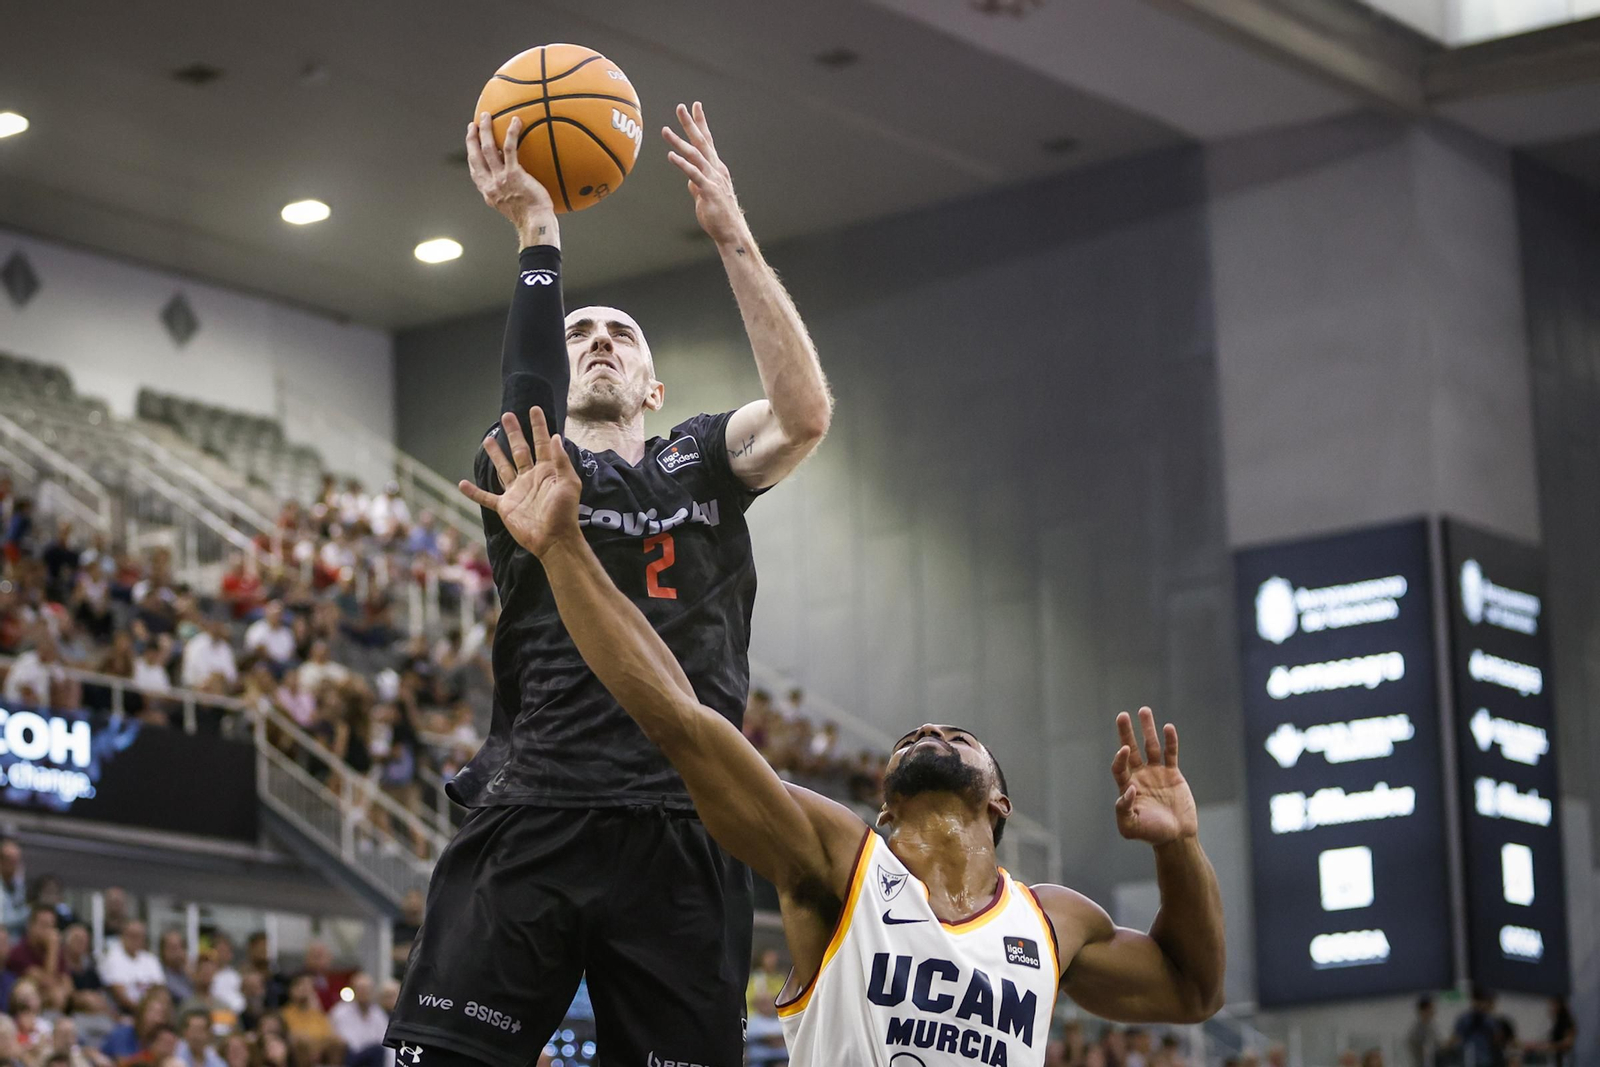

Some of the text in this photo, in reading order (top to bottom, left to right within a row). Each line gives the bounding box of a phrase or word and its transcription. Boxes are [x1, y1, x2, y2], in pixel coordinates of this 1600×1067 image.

[662, 451, 680, 464] liga
[667, 452, 700, 468] endesa
[643, 533, 677, 599] 2
[1007, 944, 1024, 955] liga
[1008, 954, 1039, 966] endesa
[418, 994, 454, 1010] vive
[867, 952, 1038, 1048] UCAM
[886, 1017, 1008, 1067] MURCIA
